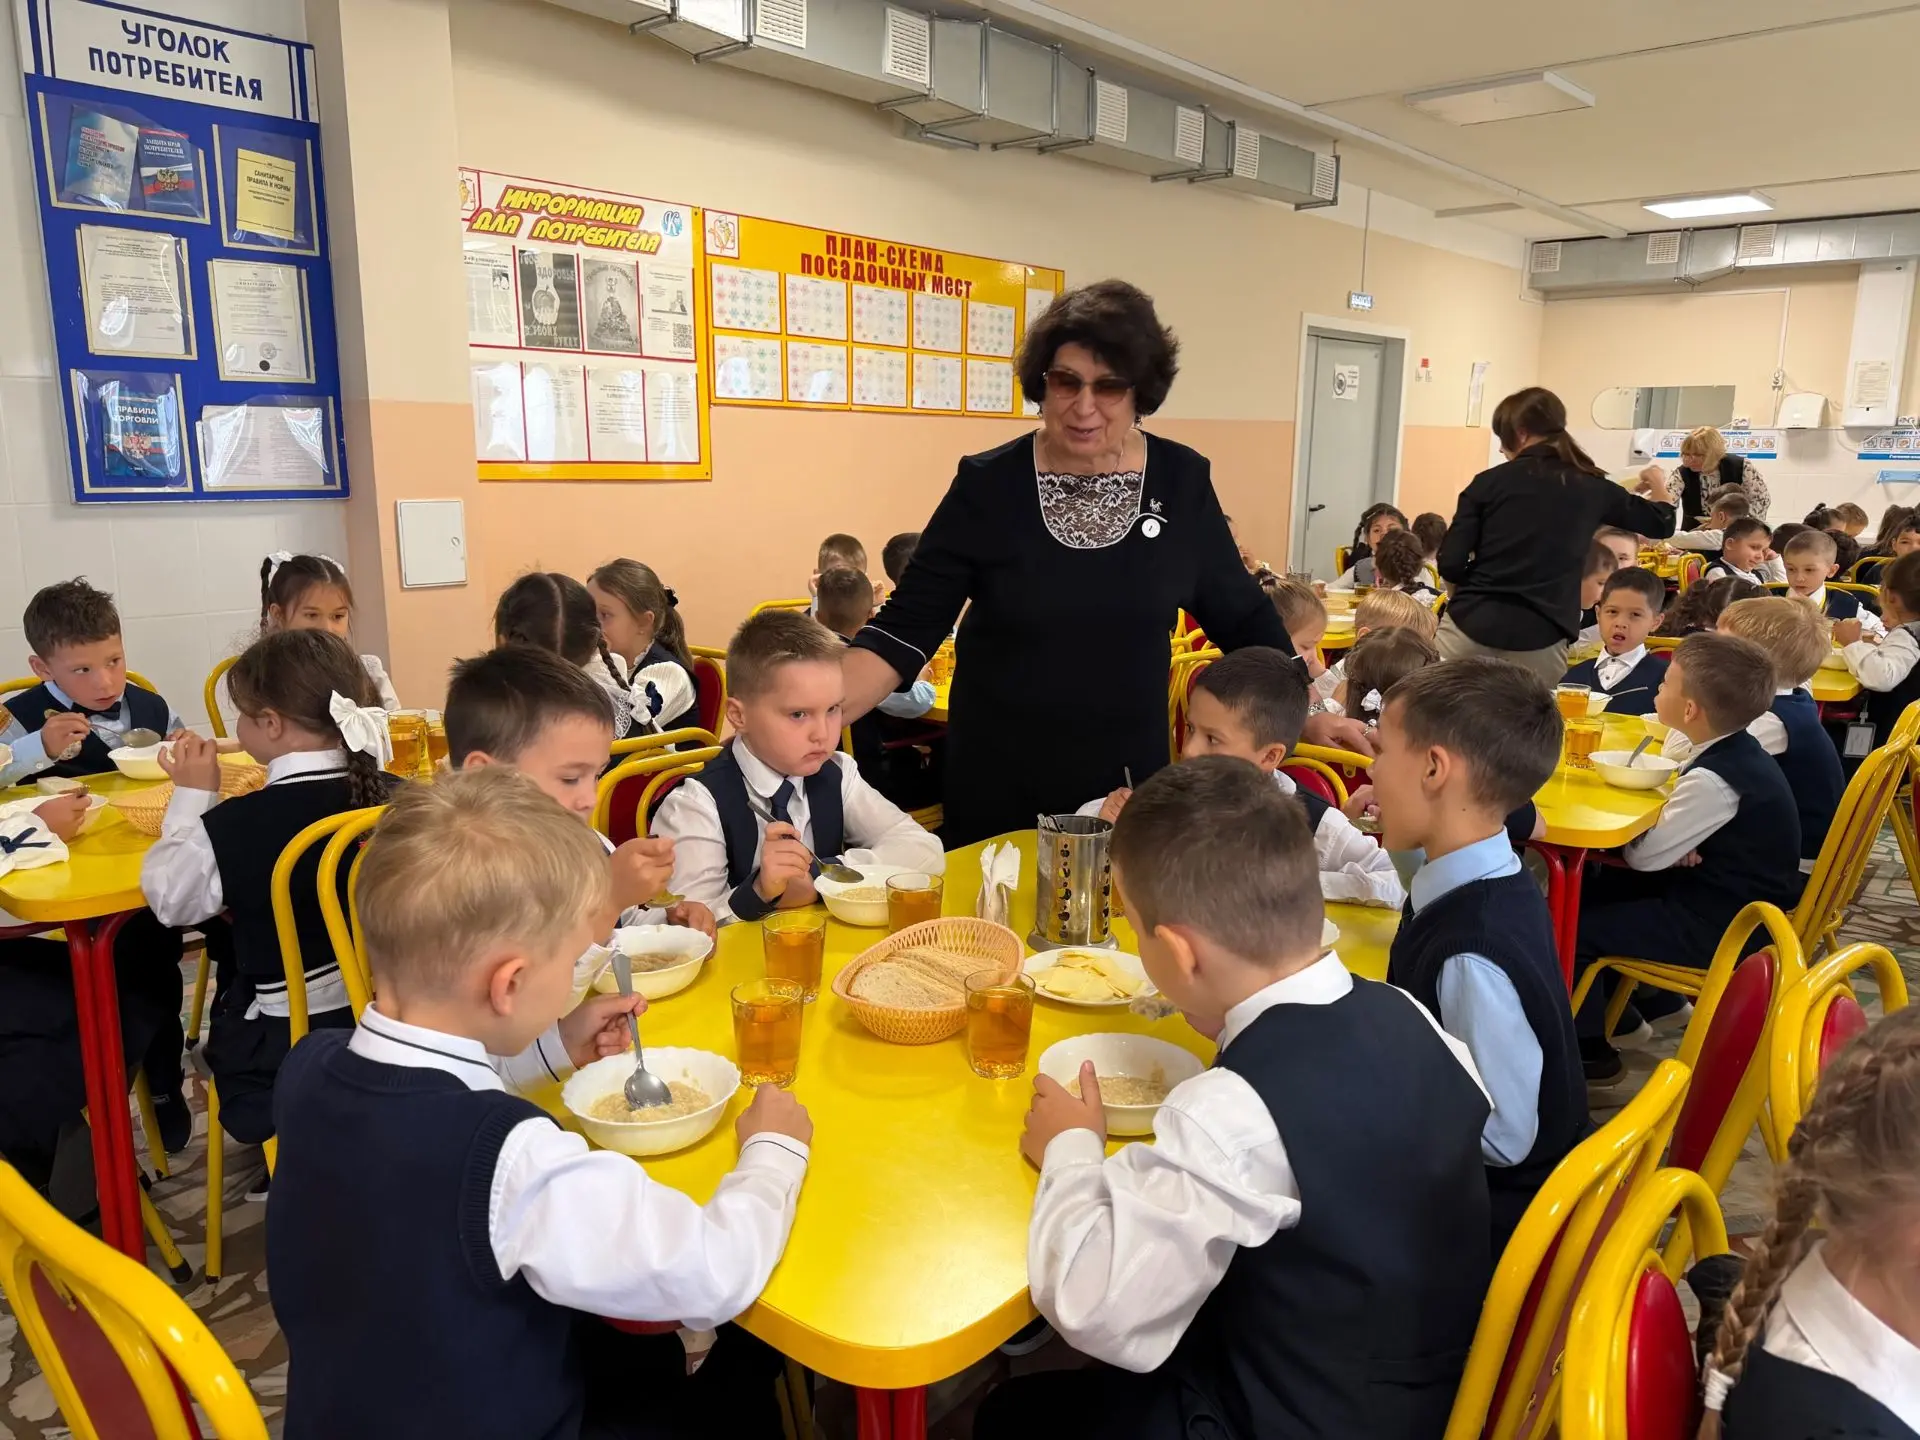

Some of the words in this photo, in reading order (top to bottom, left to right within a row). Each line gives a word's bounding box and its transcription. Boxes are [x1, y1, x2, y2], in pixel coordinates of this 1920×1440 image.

[121, 19, 230, 63] УГОЛОК
[89, 47, 263, 101] ПОТРЕБИТЕЛЯ
[246, 176, 269, 186] ПРАВИЛА
[274, 182, 291, 192] НОРМЫ
[254, 170, 284, 182] САНИТАРНЫЕ
[501, 187, 643, 226] ИНФОРМАЦИЯ
[472, 210, 521, 235] ДЛЯ
[531, 218, 661, 253] ПОТРЕБИТЕЛЯ
[826, 234, 944, 274] ПЛАН-СХЕМА
[113, 414, 159, 425] ТОРГОВЛИ
[115, 405, 157, 416] ПРАВИЛА
